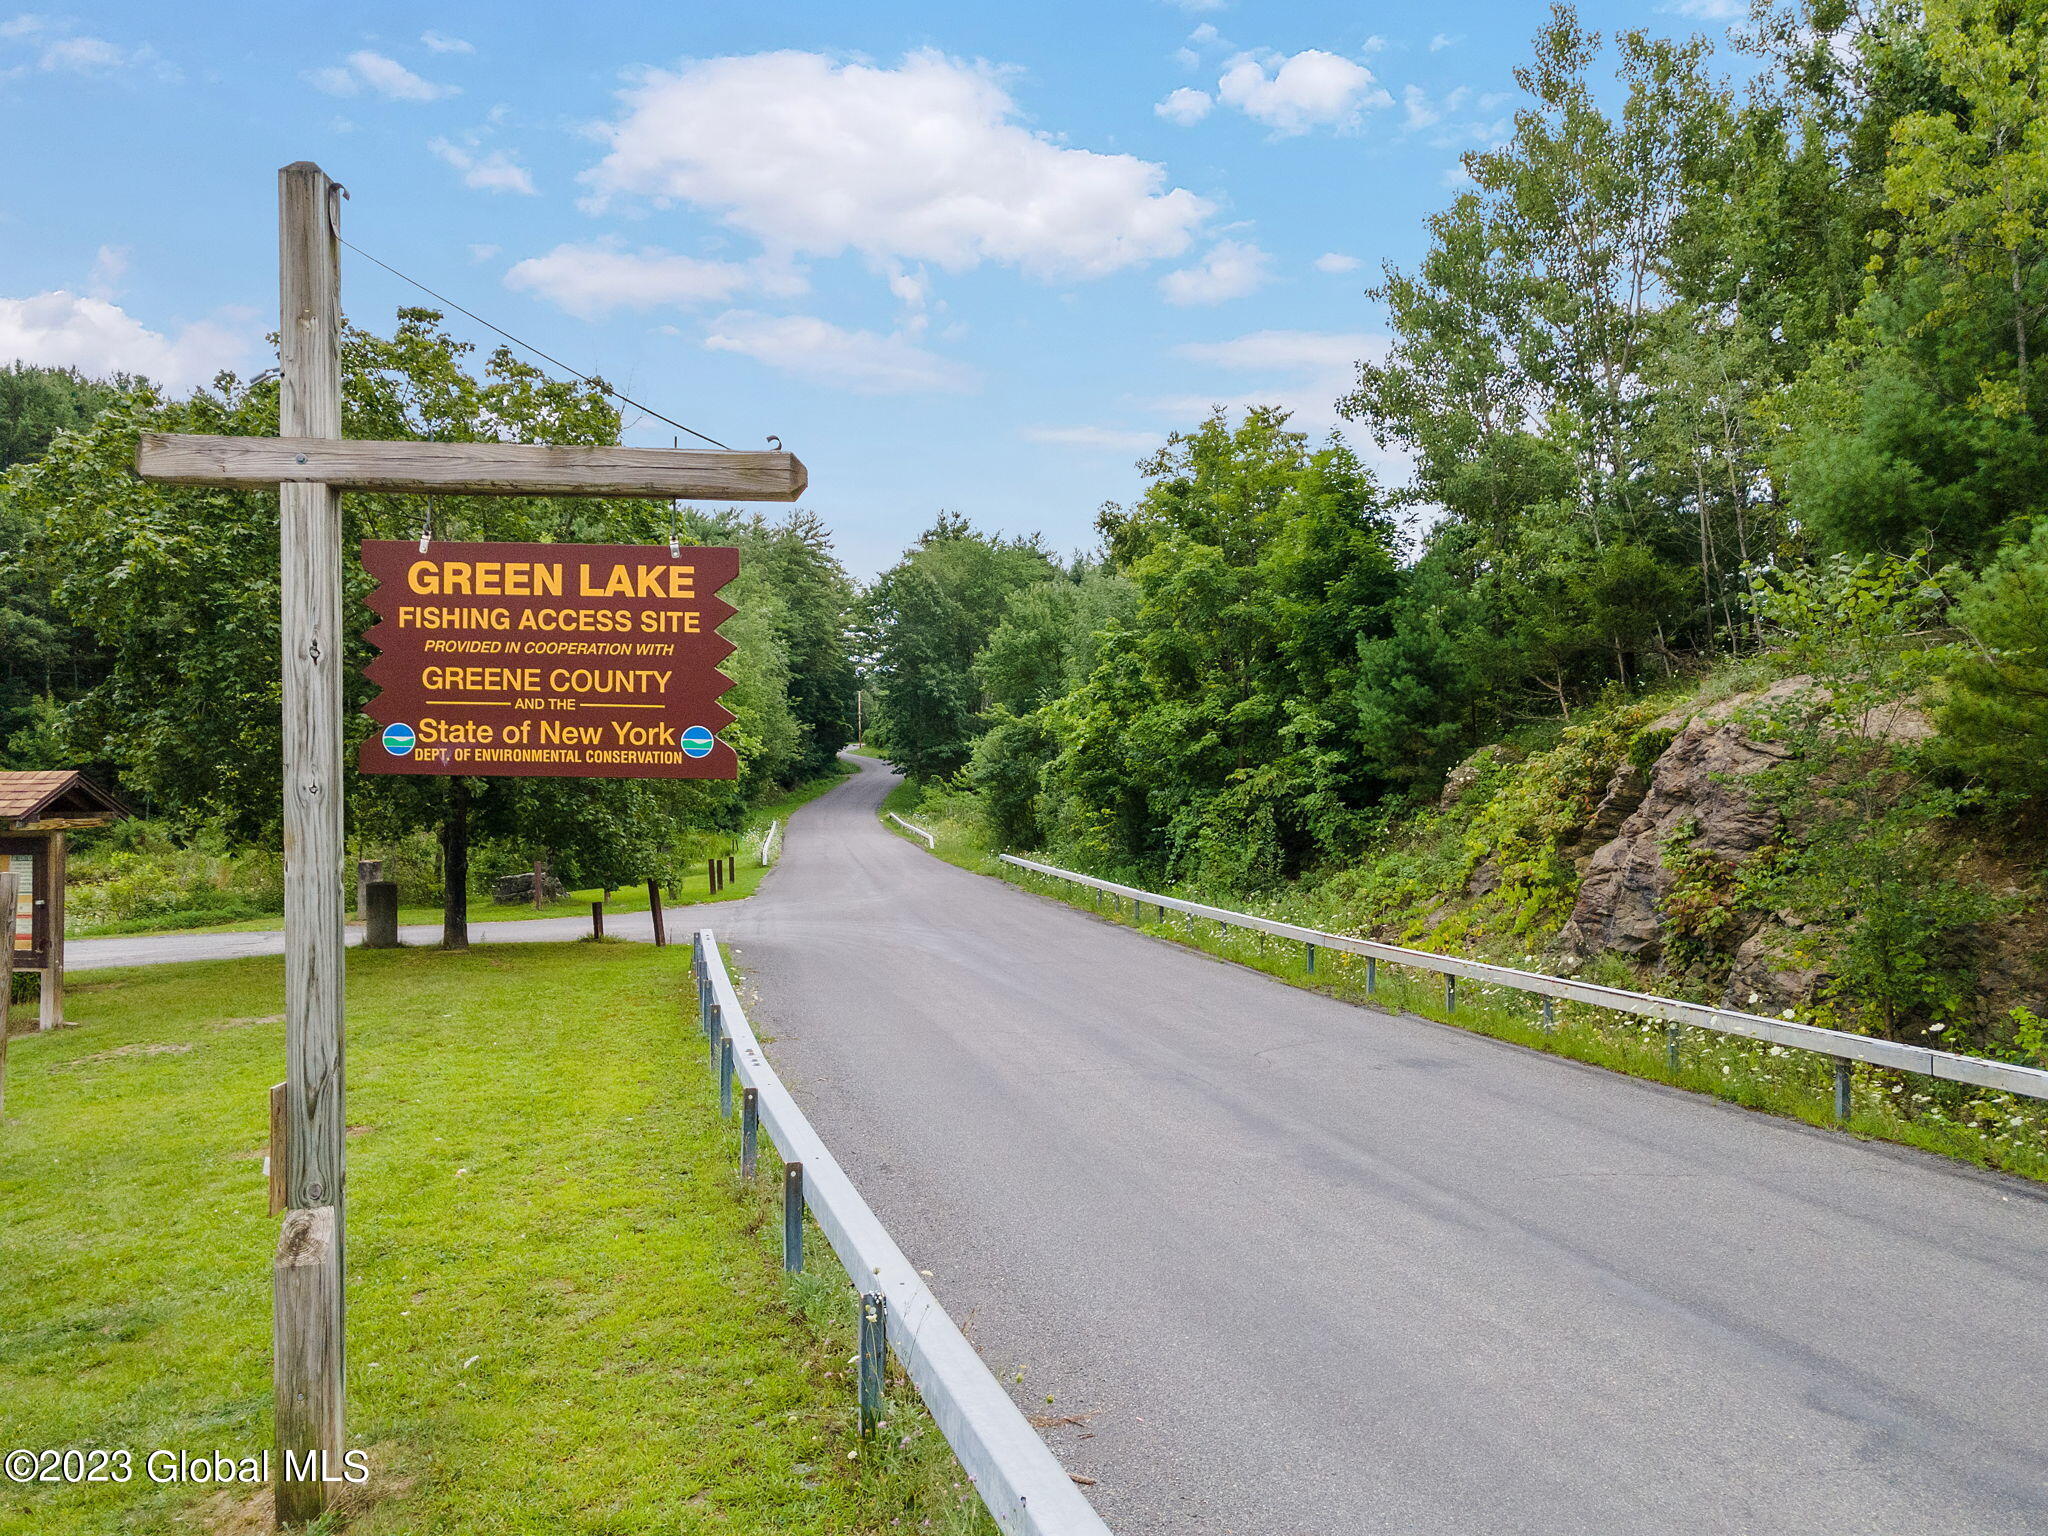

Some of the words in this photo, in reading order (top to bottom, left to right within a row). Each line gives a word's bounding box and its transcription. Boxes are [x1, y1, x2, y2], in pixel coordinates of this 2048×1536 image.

[408, 561, 562, 596] GREEN
[580, 564, 695, 598] LAKE
[399, 607, 510, 630] FISHING
[518, 609, 632, 632] ACCESS
[641, 611, 700, 633] SITE
[425, 640, 501, 653] PROVIDED
[505, 641, 519, 654] IN
[524, 642, 632, 655] COOPERATION
[637, 644, 674, 656] WITH
[422, 667, 541, 691] GREENE
[550, 669, 672, 693] COUNTY
[515, 698, 544, 709] AND
[548, 699, 575, 710] THE
[419, 718, 493, 743] State
[503, 720, 531, 743] of
[540, 721, 602, 744] New
[611, 721, 675, 745] York
[415, 748, 450, 761] DEPT.
[455, 748, 471, 761] OF
[475, 749, 582, 762] ENVIRONMENTAL
[586, 750, 682, 764] CONSERVATION
